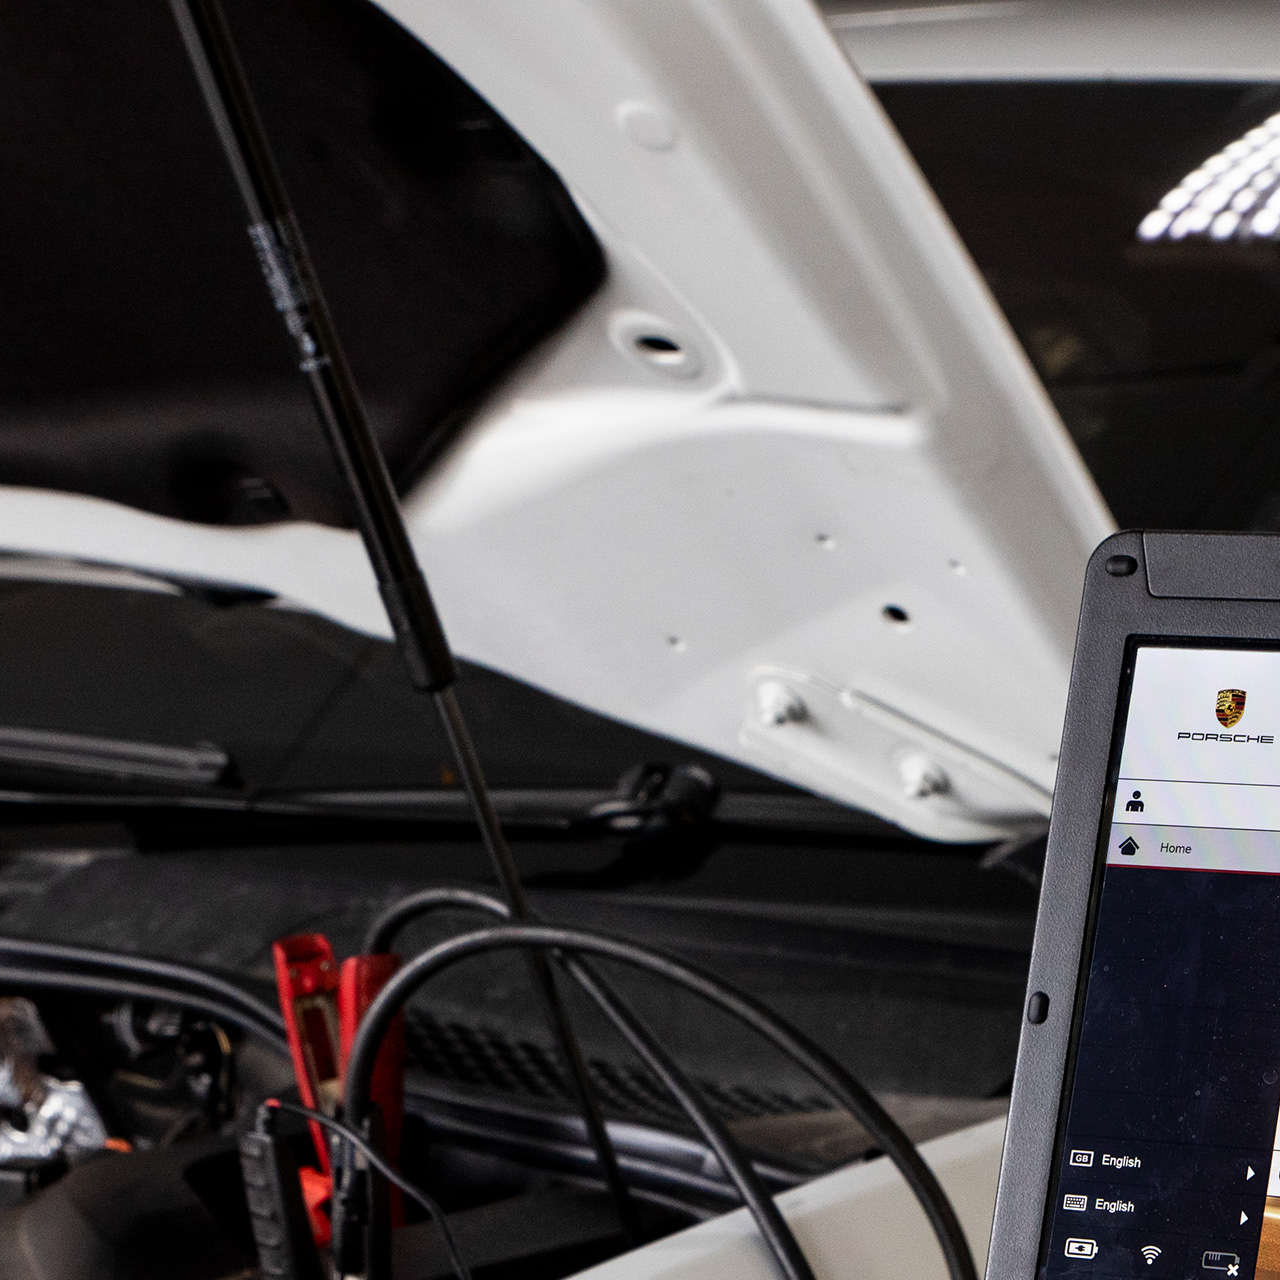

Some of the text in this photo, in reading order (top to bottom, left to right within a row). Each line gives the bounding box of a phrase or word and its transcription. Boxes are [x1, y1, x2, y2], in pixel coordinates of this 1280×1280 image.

[1177, 731, 1274, 744] PORSCHE
[1160, 841, 1192, 855] Home
[1075, 1153, 1088, 1163] GB
[1102, 1154, 1141, 1170] English
[1095, 1198, 1135, 1214] English
